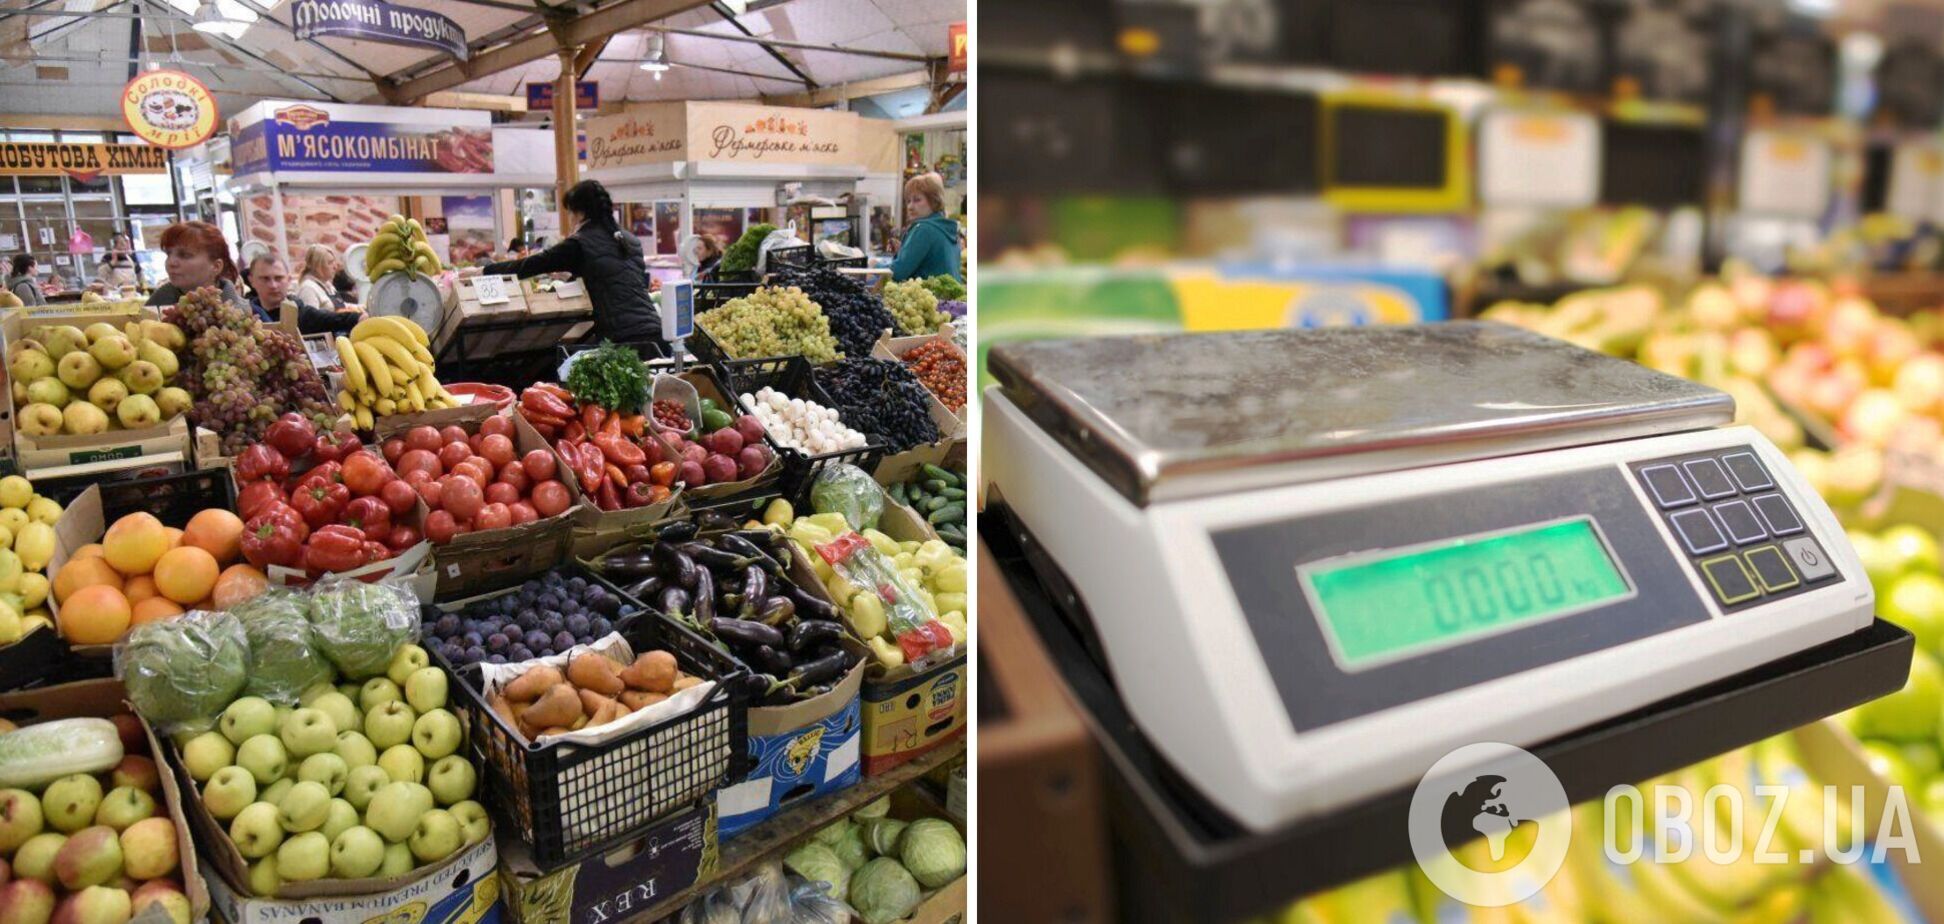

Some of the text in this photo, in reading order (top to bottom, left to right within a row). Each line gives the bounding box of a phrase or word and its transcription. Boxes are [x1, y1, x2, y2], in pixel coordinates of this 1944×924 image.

[297, 0, 381, 26] Молочні
[127, 77, 205, 104] Солодкі
[105, 145, 166, 168] ХІМІЯ
[259, 838, 493, 920] SELECTED PREMIUM BANANAS
[591, 878, 657, 924] REX
